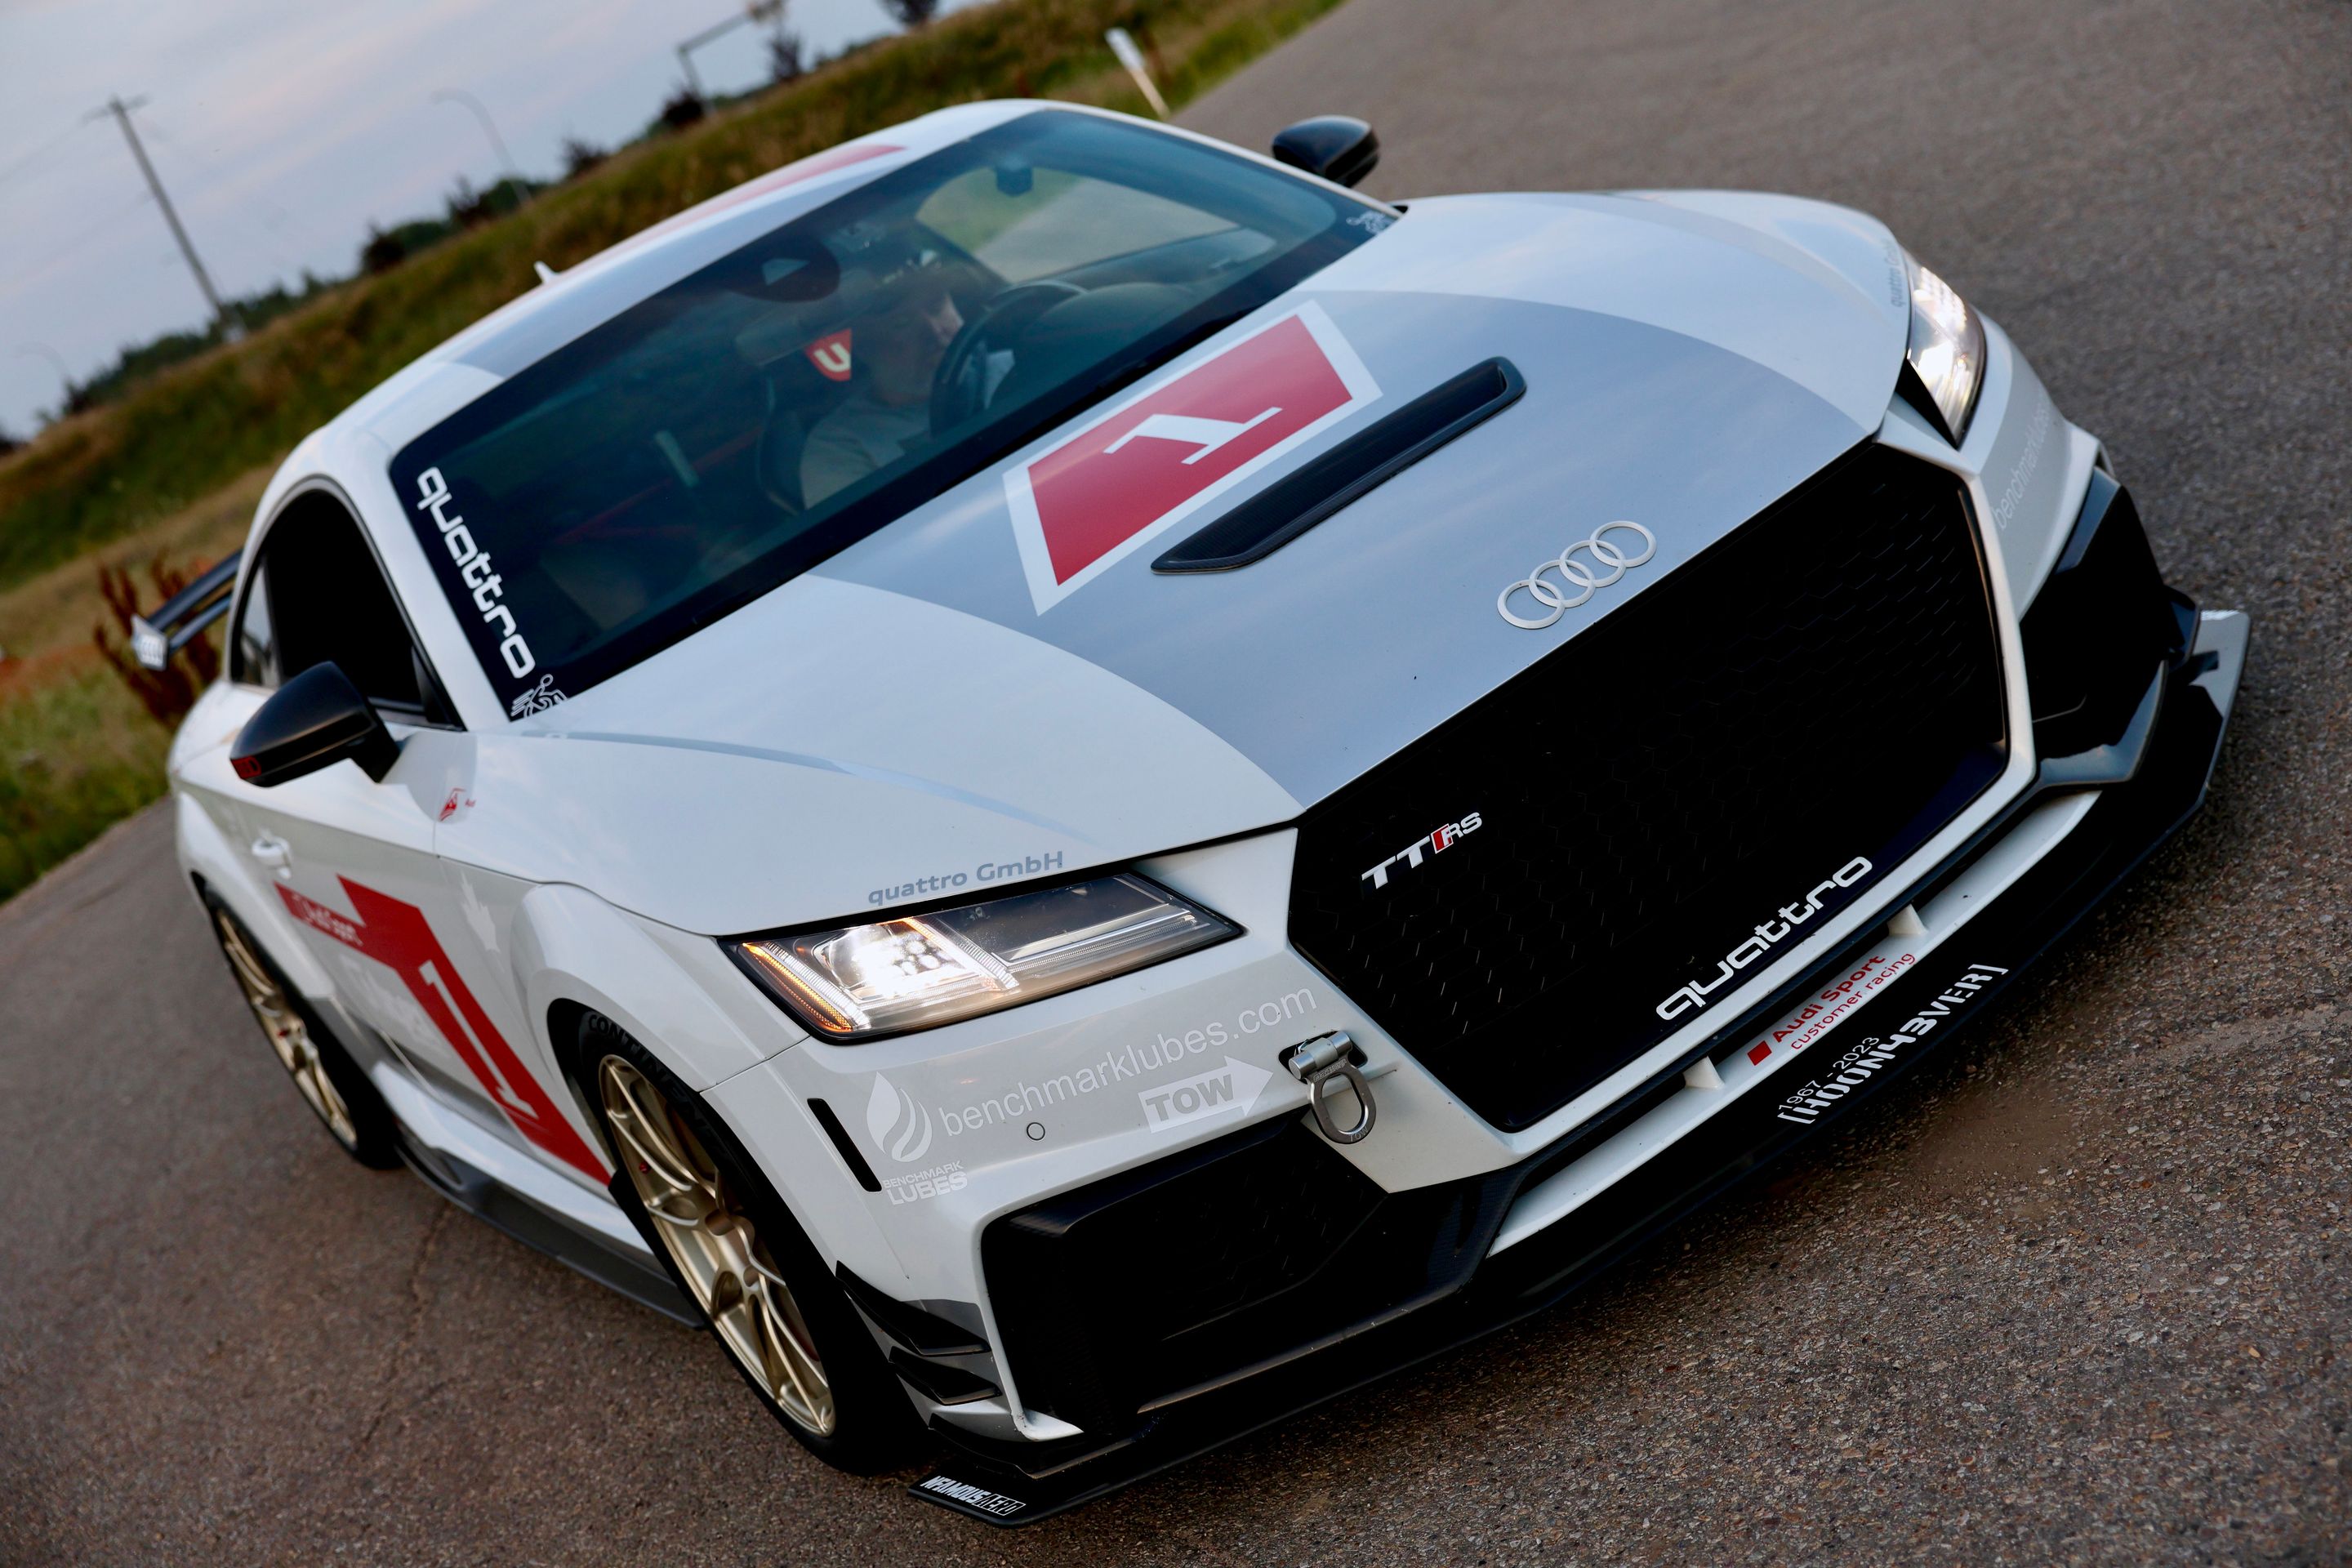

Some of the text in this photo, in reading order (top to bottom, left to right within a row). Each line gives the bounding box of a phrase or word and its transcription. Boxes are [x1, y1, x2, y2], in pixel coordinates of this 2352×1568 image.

[416, 466, 537, 679] quattro
[867, 850, 1064, 906] quattro GmbH
[1655, 856, 1873, 1021] quattro
[1771, 955, 1886, 1044] Audi Sport
[1790, 952, 1917, 1050] customer racing
[938, 987, 1317, 1137] benchmarklubes.com
[1145, 1075, 1235, 1122] TOW
[1778, 1080, 1822, 1111] 1967
[1836, 1036, 1880, 1069] 2023
[1349, 1126, 1370, 1142] TOW
[881, 1160, 964, 1190] BENCHMARK
[886, 1170, 969, 1205] LUBES
